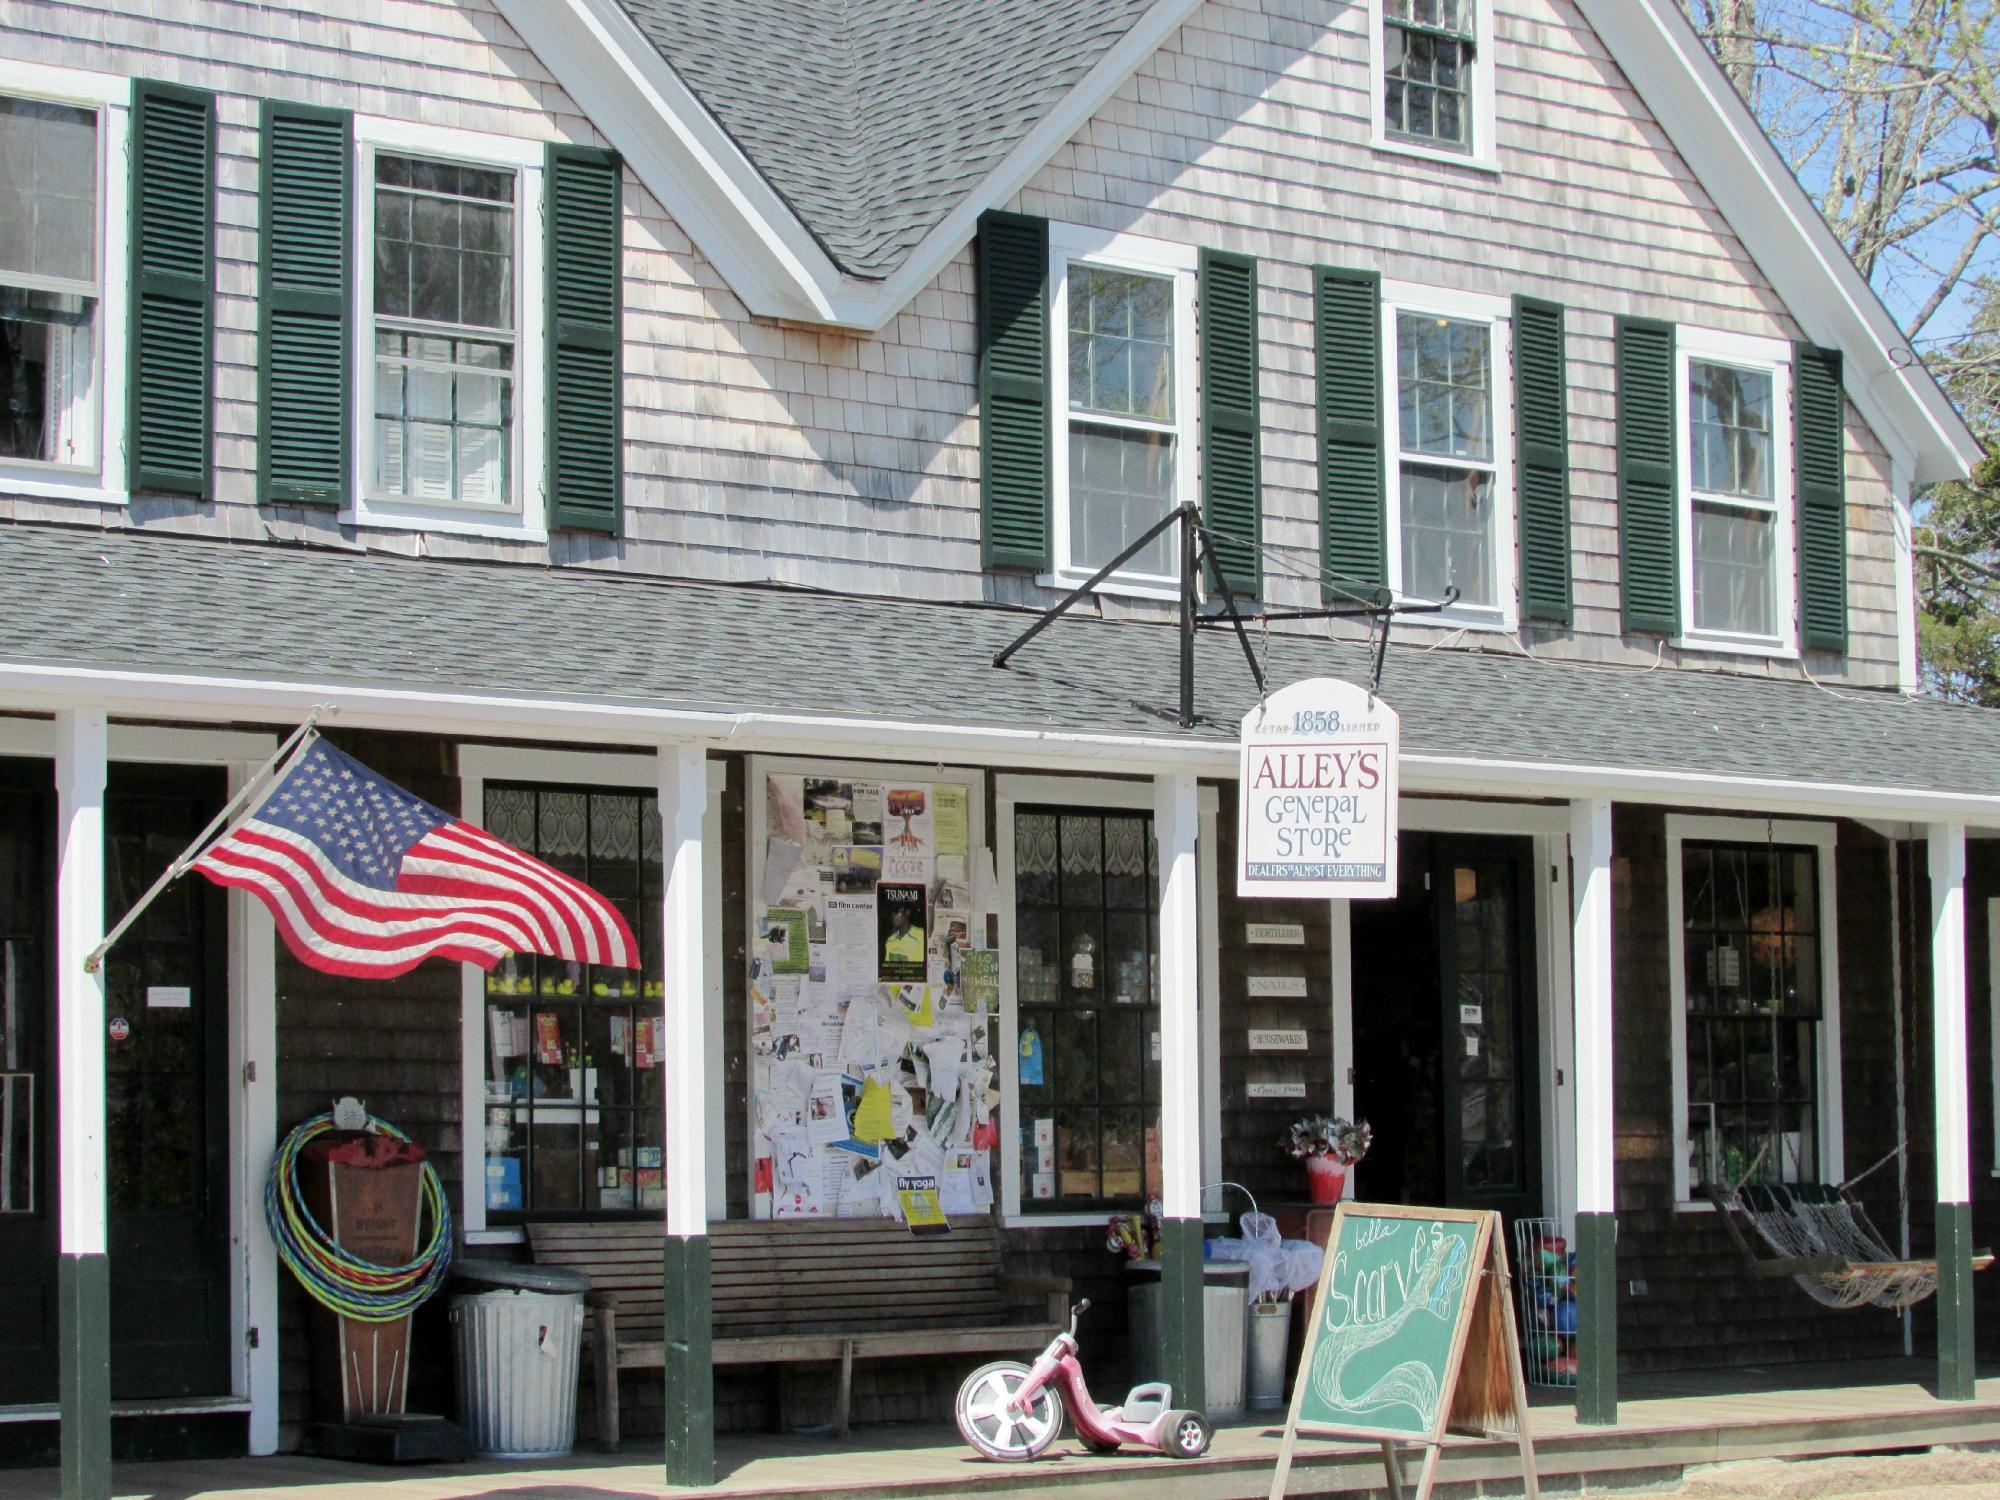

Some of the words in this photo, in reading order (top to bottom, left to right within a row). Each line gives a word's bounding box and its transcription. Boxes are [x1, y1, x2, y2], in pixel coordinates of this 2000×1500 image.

[1292, 710, 1340, 733] 1858
[1253, 750, 1380, 790] ALLEY'S
[1248, 864, 1288, 877] DEALERS
[1327, 864, 1382, 878] EVERYTHING
[885, 889, 918, 901] TSUNAMI
[838, 901, 851, 909] film
[1255, 928, 1300, 938] FERTILIZER
[1256, 980, 1300, 991] NAILS
[1256, 1034, 1303, 1045] HOUSEWARES
[898, 1177, 910, 1190] fly
[912, 1179, 935, 1190] yoga
[1355, 1218, 1401, 1250] bella
